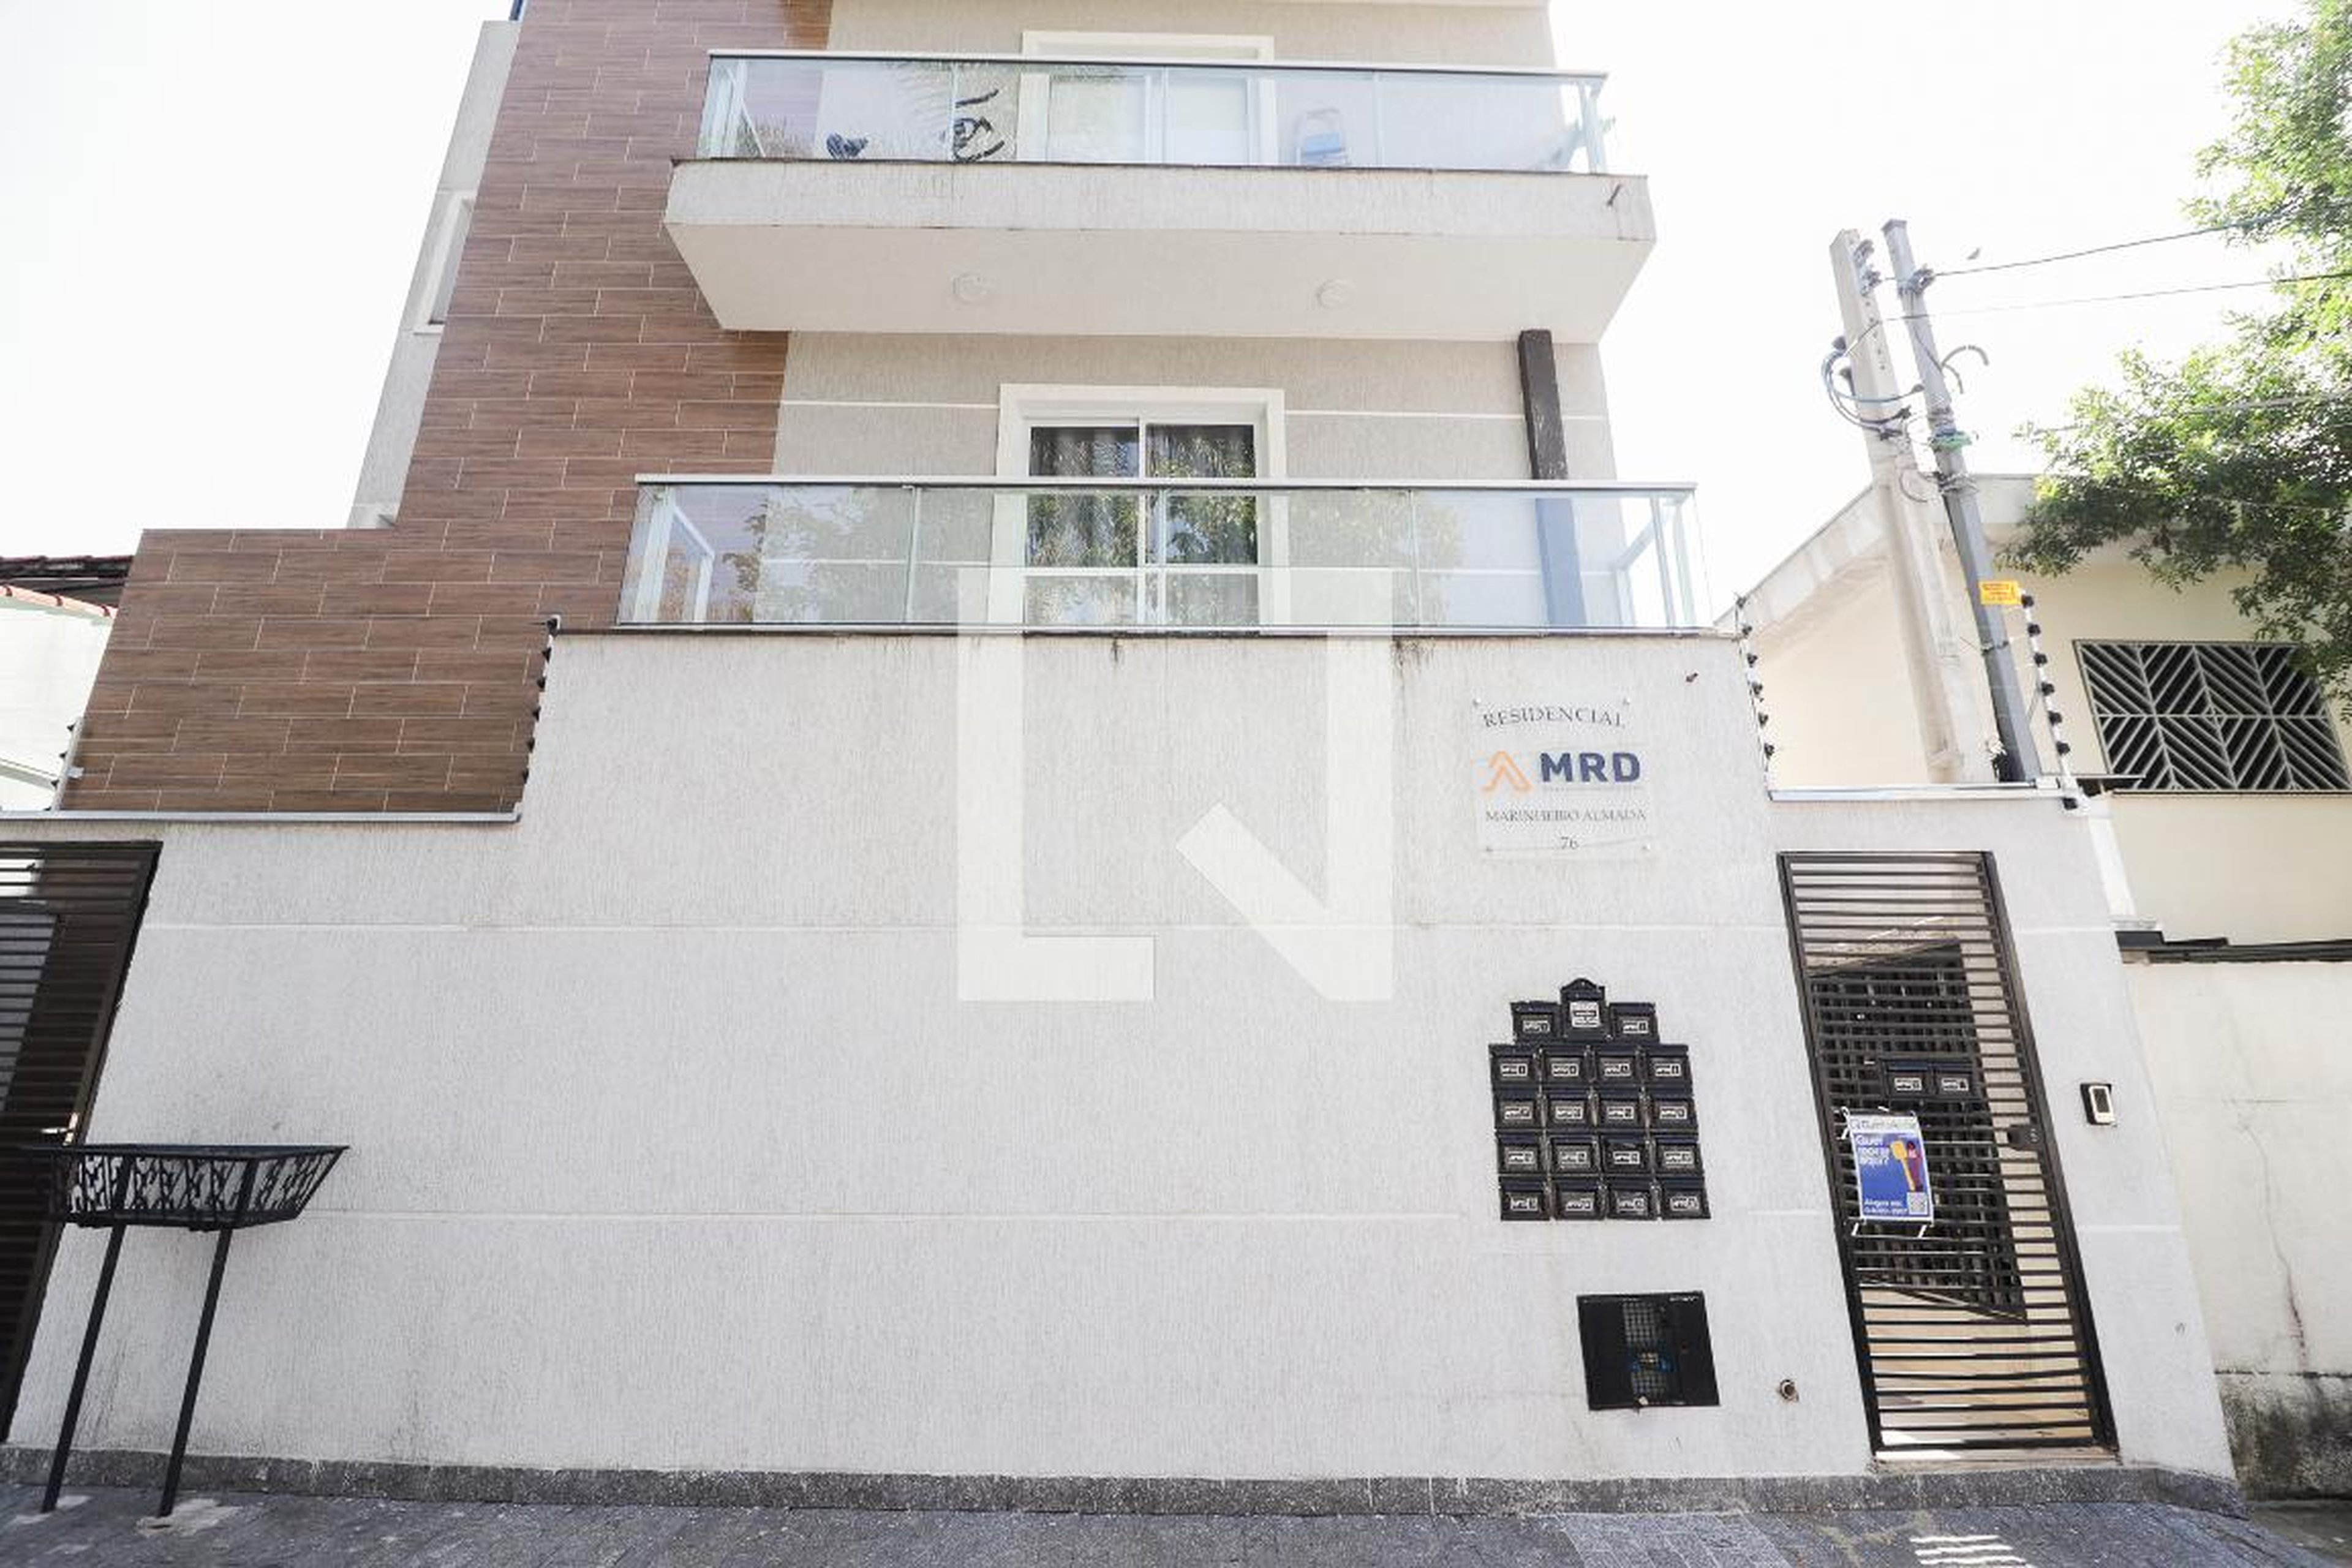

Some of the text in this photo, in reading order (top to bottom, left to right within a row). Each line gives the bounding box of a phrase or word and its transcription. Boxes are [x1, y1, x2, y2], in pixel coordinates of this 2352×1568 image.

[1483, 706, 1625, 727] RESIDENCIAL
[1540, 752, 1640, 782] MRD
[1561, 837, 1579, 850] 76
